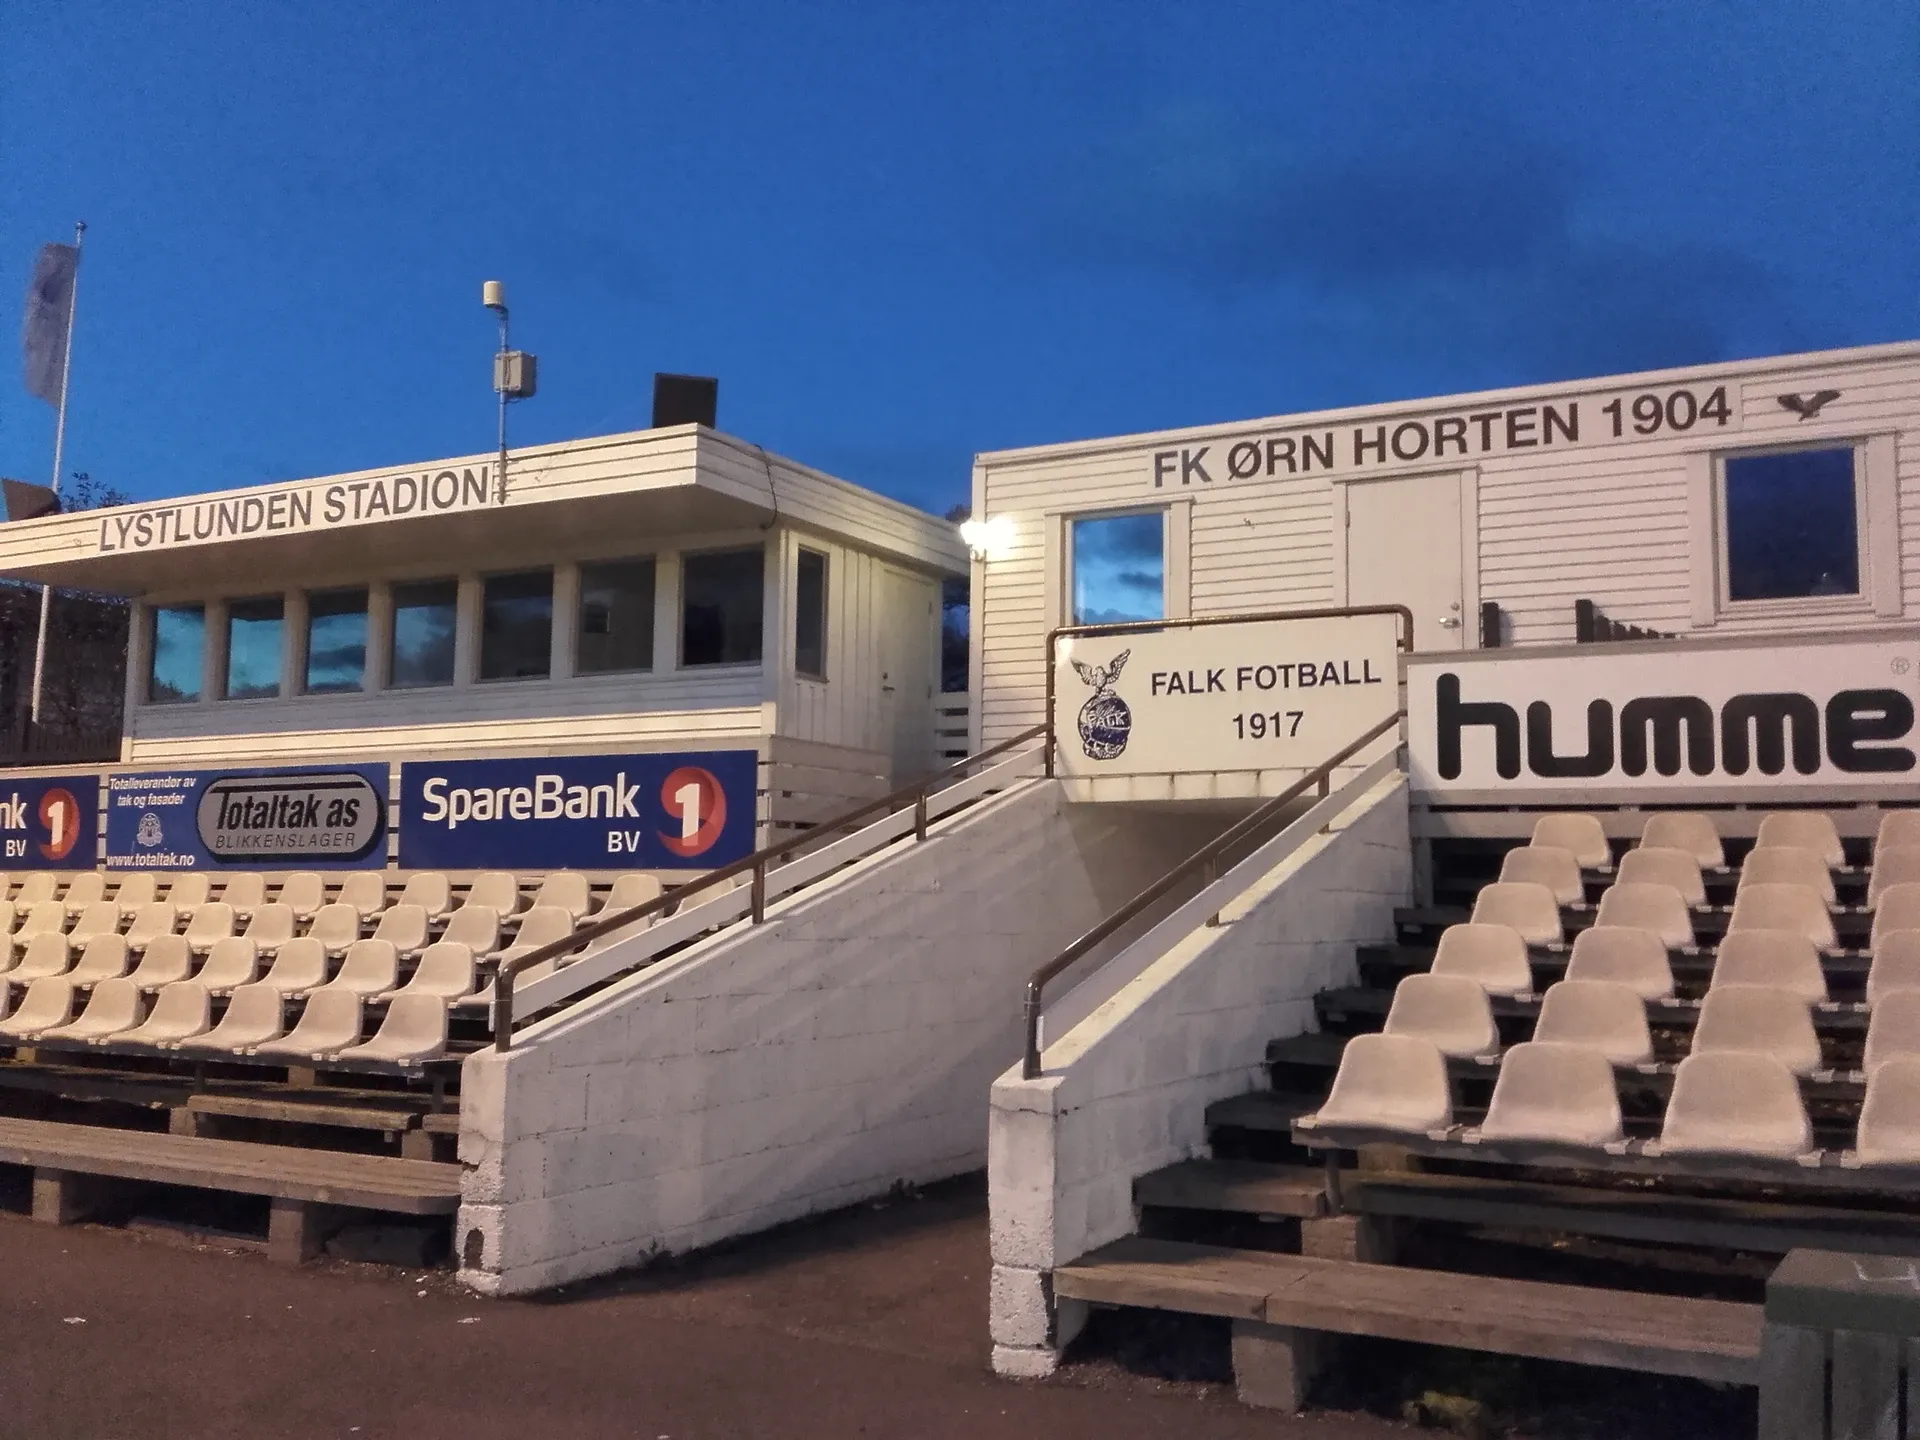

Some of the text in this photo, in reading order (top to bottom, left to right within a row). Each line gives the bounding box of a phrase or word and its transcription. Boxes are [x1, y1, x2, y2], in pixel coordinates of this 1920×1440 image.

[1154, 386, 1732, 488] FK ØRN HORTEN 1904
[99, 465, 489, 552] LYSTLUNDEN STADION
[1151, 659, 1382, 696] FALK FOTBALL
[1232, 711, 1304, 740] 1917
[1437, 672, 1917, 780] humme
[183, 776, 197, 787] av
[117, 793, 186, 808] tak og fasader
[214, 786, 360, 830] Totaltak as
[422, 771, 641, 829] SpareBank
[5, 838, 27, 858] BV
[215, 832, 356, 849] BLIKKENSLAGER
[607, 830, 641, 853] BV
[106, 851, 196, 868] www.totaltak.no
